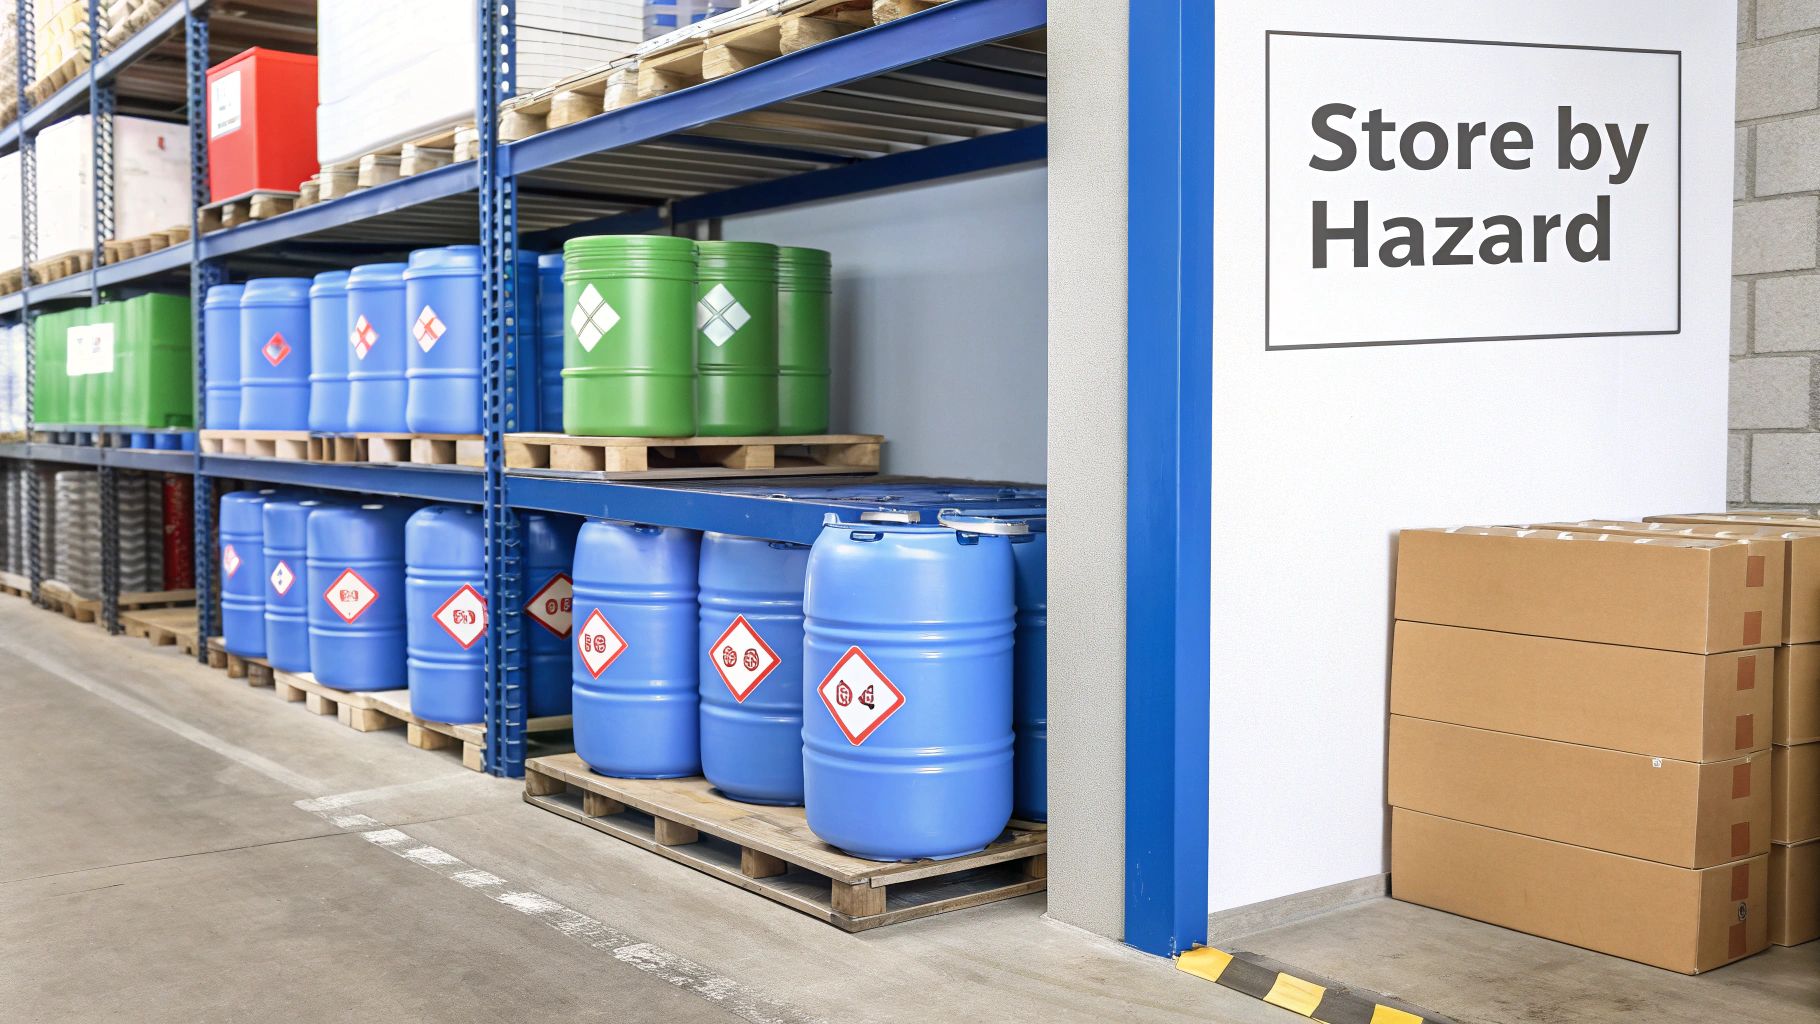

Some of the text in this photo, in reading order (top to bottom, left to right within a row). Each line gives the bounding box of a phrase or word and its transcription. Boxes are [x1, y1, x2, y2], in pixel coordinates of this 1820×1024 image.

[1309, 103, 1648, 184] Store by
[1313, 195, 1610, 268] Hazard
